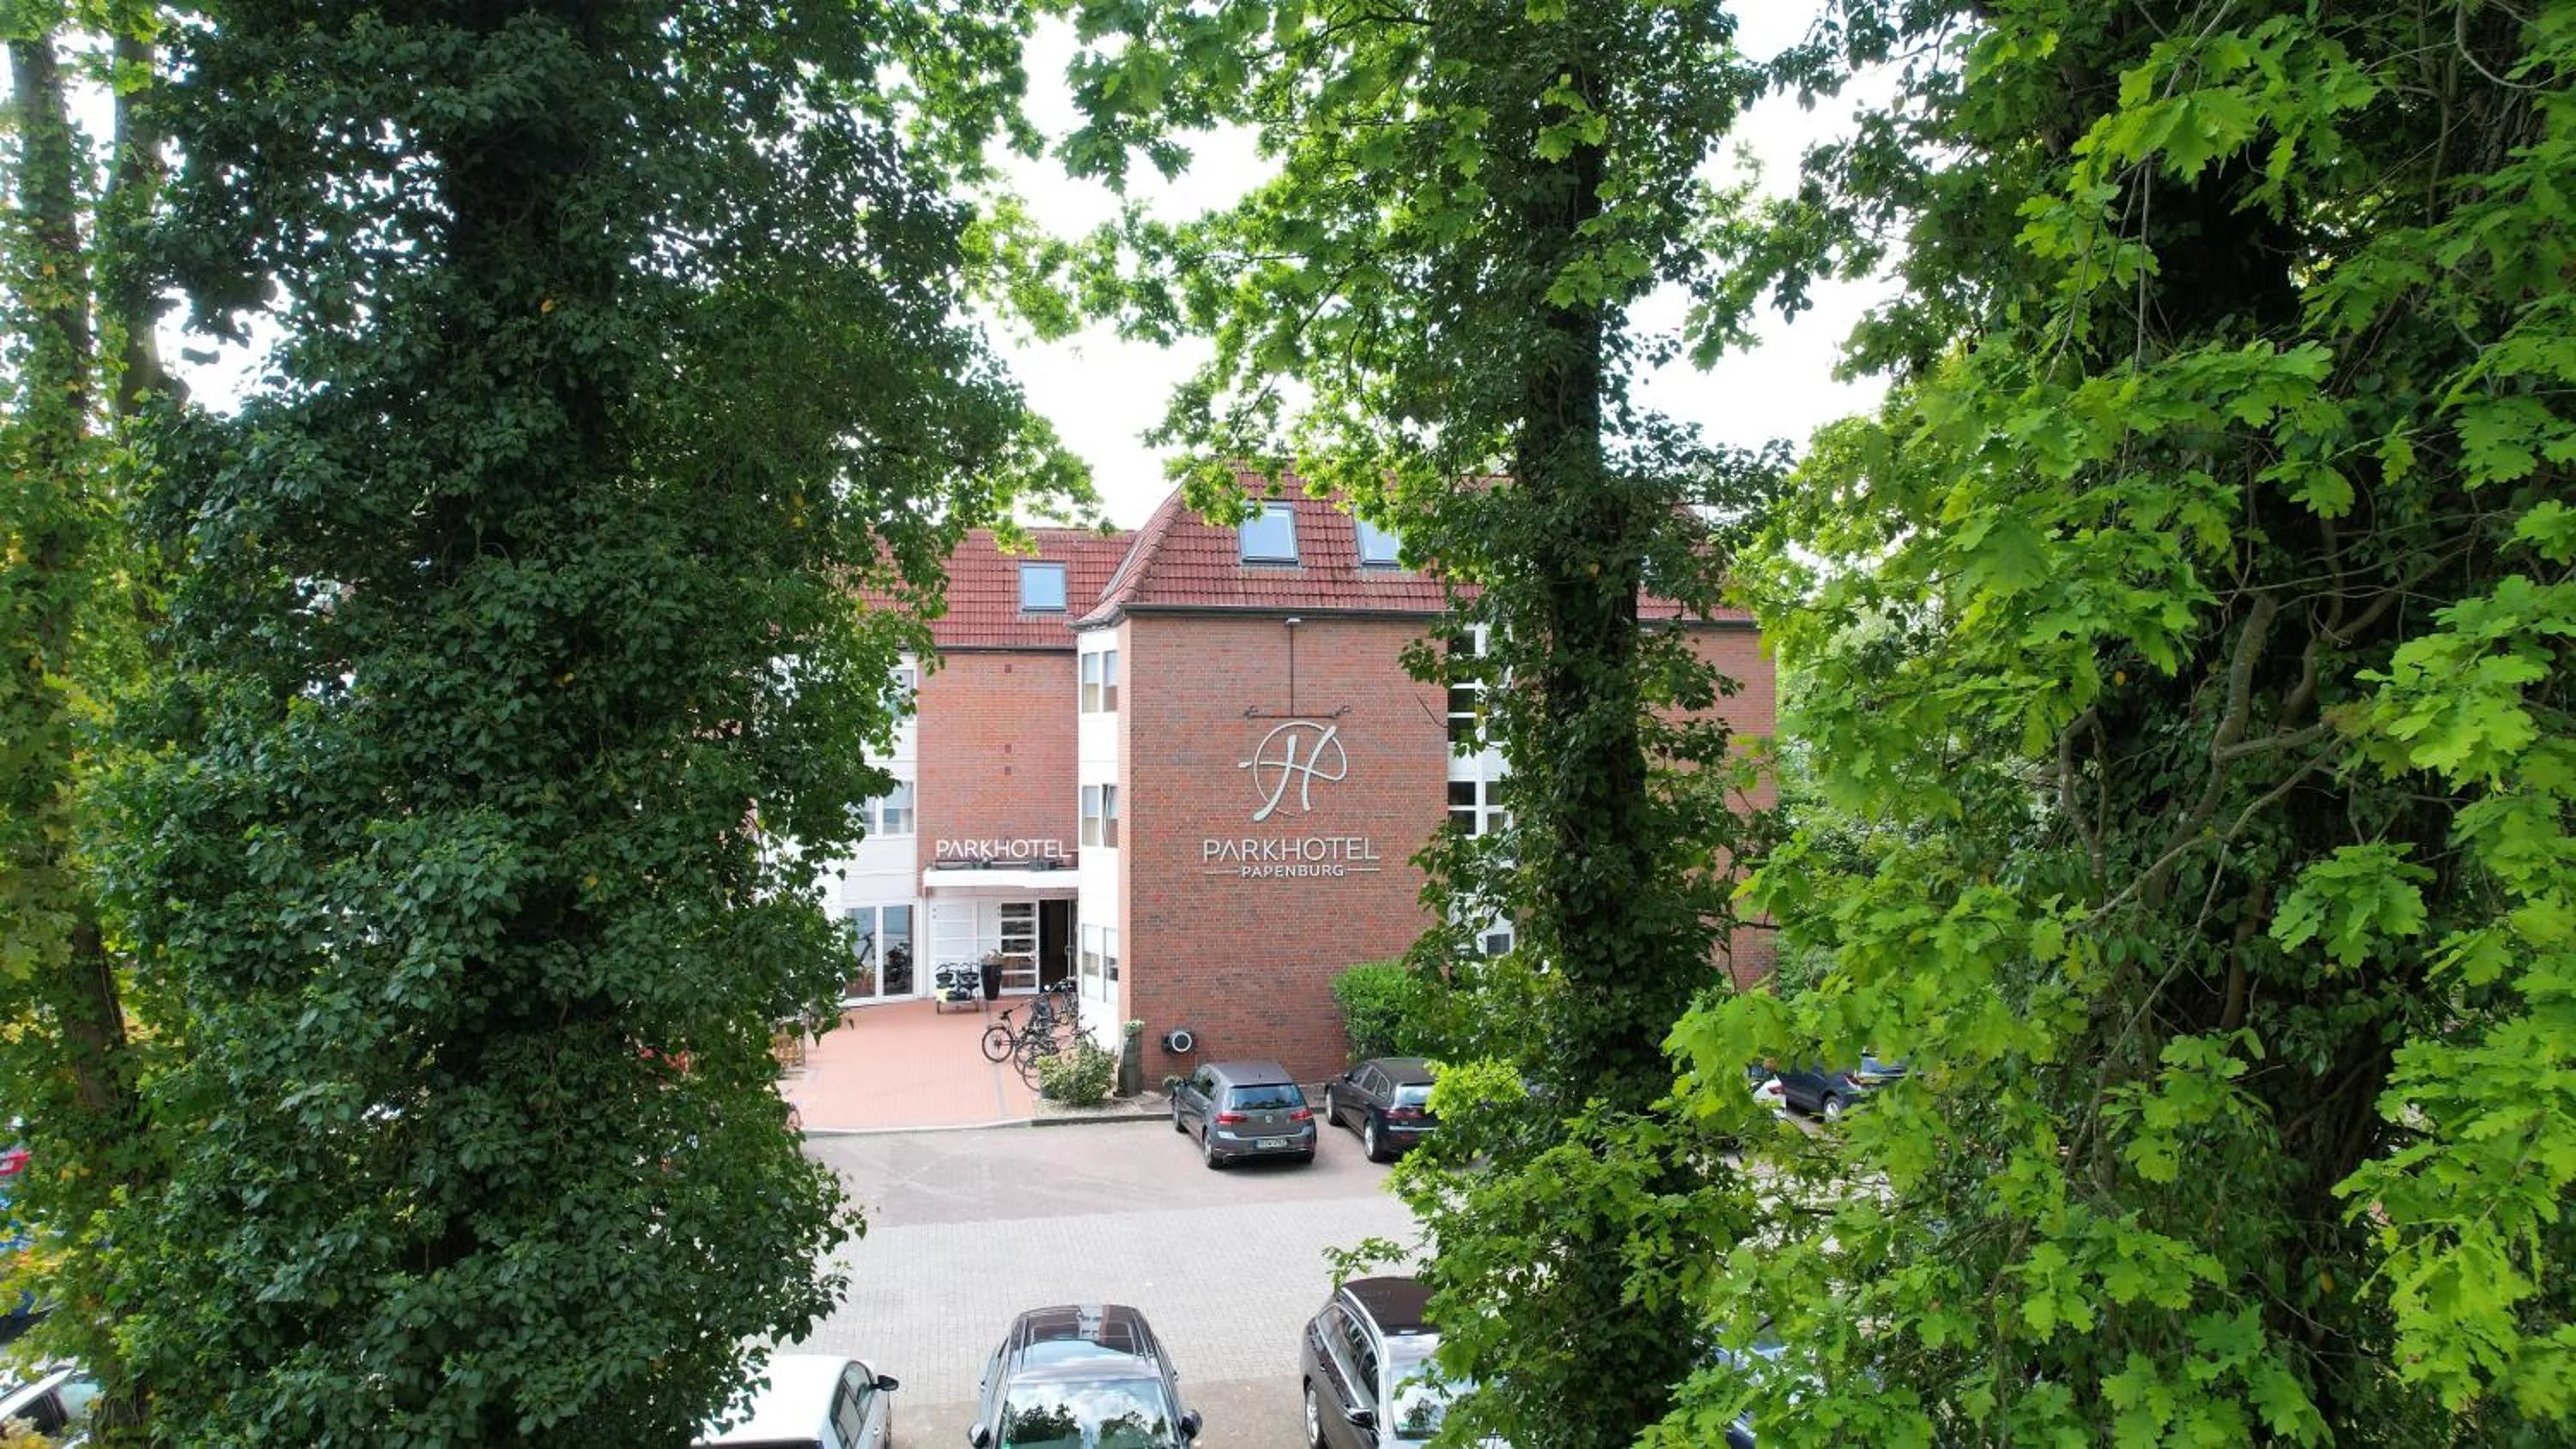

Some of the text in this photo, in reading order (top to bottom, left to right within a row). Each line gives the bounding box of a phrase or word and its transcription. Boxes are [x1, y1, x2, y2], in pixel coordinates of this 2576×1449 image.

[935, 838, 1072, 858] PARKHOTEL
[1202, 837, 1380, 862] PARKHOTEL
[1241, 864, 1345, 878] PAPENBURG
